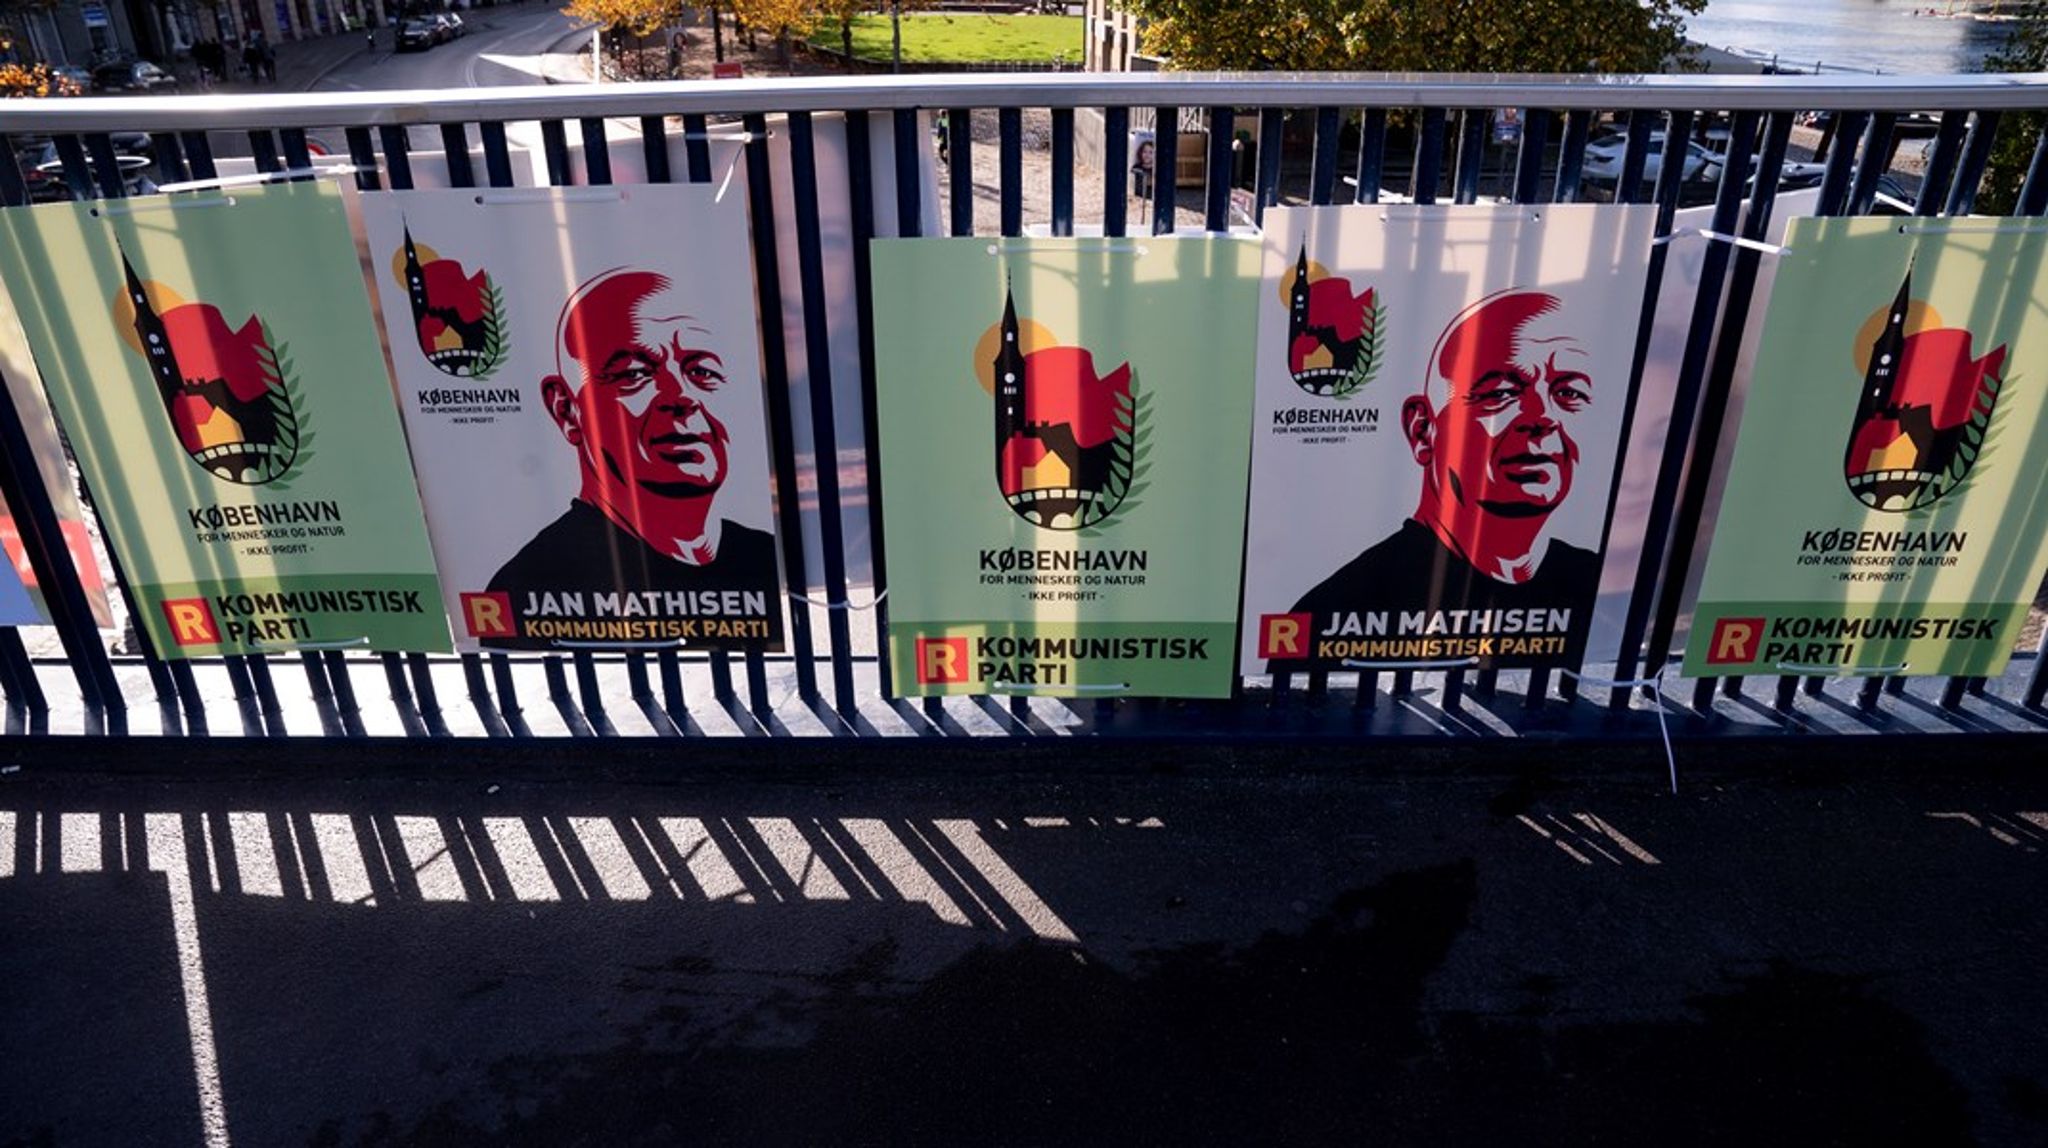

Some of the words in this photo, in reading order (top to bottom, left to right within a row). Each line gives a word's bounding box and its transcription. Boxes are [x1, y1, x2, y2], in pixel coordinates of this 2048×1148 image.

[418, 388, 520, 405] KØBENHAVN
[1273, 407, 1379, 426] KØBENHAVN
[188, 500, 341, 530] KØBENHAVN
[197, 533, 220, 543] FOR
[222, 528, 289, 541] MENNESKER
[290, 527, 306, 537] OG
[307, 526, 345, 537] NATUR
[1802, 527, 1967, 554] KØBENHAVN
[246, 546, 271, 555] IKKE
[272, 544, 308, 554] PROFIT
[979, 546, 1147, 573] KØBENHAVN
[1797, 556, 1821, 566] FOR
[1822, 556, 1895, 566] MENNESKER
[1898, 556, 1914, 566] OG
[1917, 557, 1958, 566] NATUR
[979, 575, 1004, 585] FOR
[1007, 575, 1081, 585] MENNESKER
[1084, 575, 1101, 585] OG
[1104, 575, 1146, 585] NATUR
[1839, 572, 1865, 581] IKKE
[1867, 572, 1906, 581] PROFIT
[216, 591, 424, 617] KOMMUNISTISK
[523, 591, 586, 617] JAN
[594, 591, 767, 617] MATHISEN
[1029, 591, 1056, 601] IKKE
[1058, 591, 1097, 601] PROFIT
[171, 605, 212, 640] R
[470, 597, 506, 632] R
[1321, 611, 1388, 636] JAN
[1398, 608, 1571, 636] MATHISEN
[225, 618, 311, 643] PARTI
[524, 619, 698, 639] KOMMUNISTISK
[703, 619, 769, 638] PARTI
[1268, 619, 1299, 654] R
[1771, 617, 1999, 640] KOMMUNISTISK
[977, 637, 1209, 660] KOMMUNISTISK
[1318, 638, 1494, 658] KOMMUNISTISK
[1499, 637, 1566, 656] PARTI
[1717, 624, 1751, 659] R
[926, 643, 958, 678] R
[1763, 643, 1853, 664] PARTI
[977, 663, 1067, 685] PARTI
